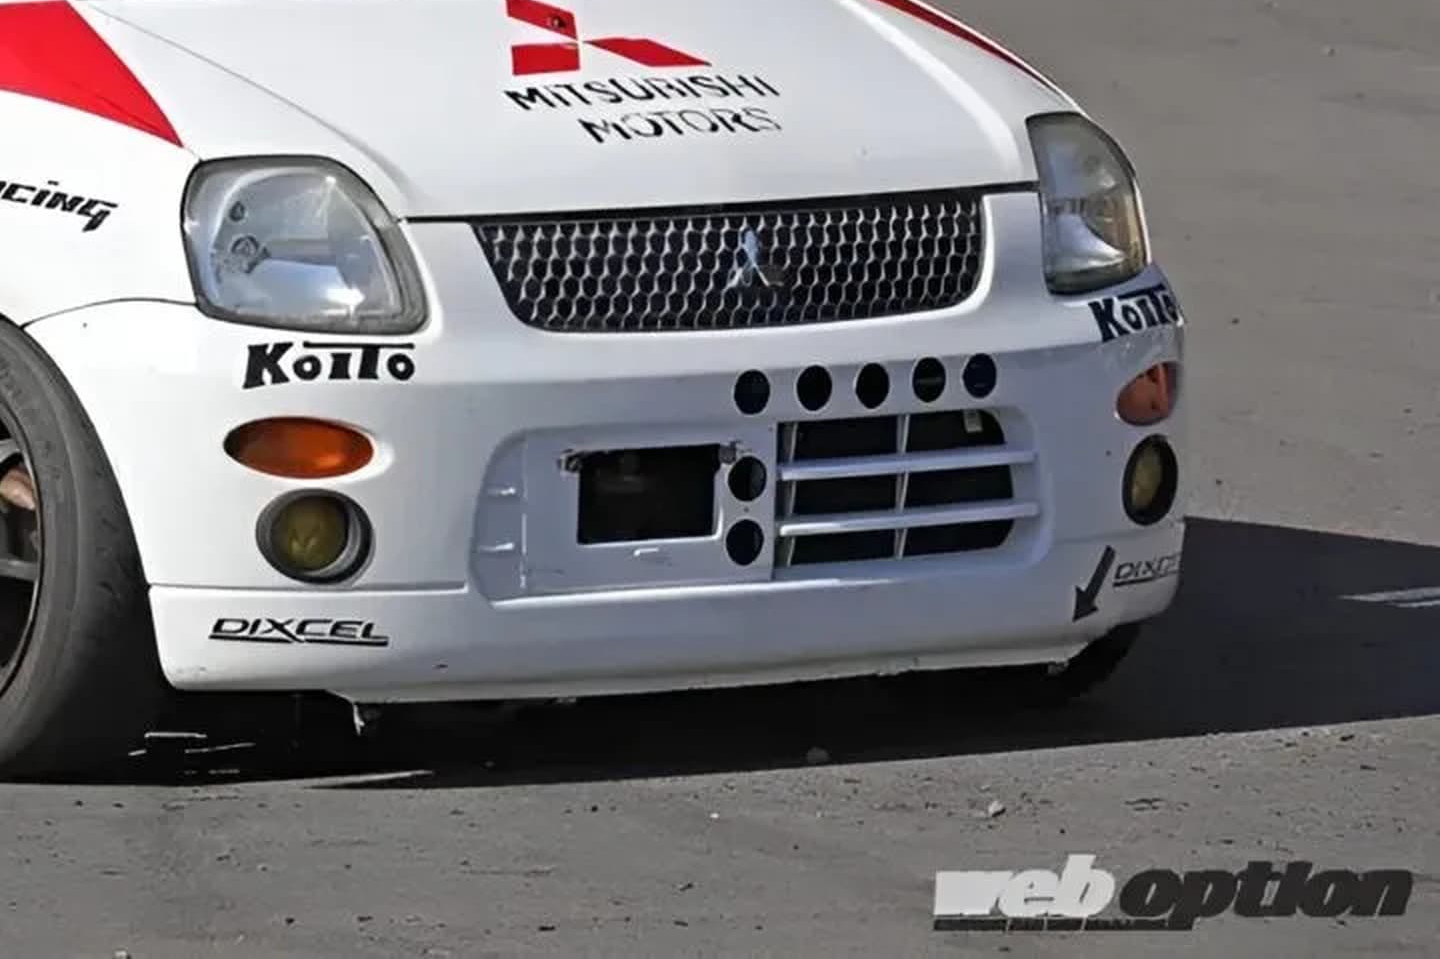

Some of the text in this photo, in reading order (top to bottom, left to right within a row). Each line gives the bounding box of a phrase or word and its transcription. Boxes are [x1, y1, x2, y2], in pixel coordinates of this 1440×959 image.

[503, 75, 781, 111] MITSUBISHI
[578, 107, 782, 144] MOTORS
[208, 618, 389, 647] DIXCEL
